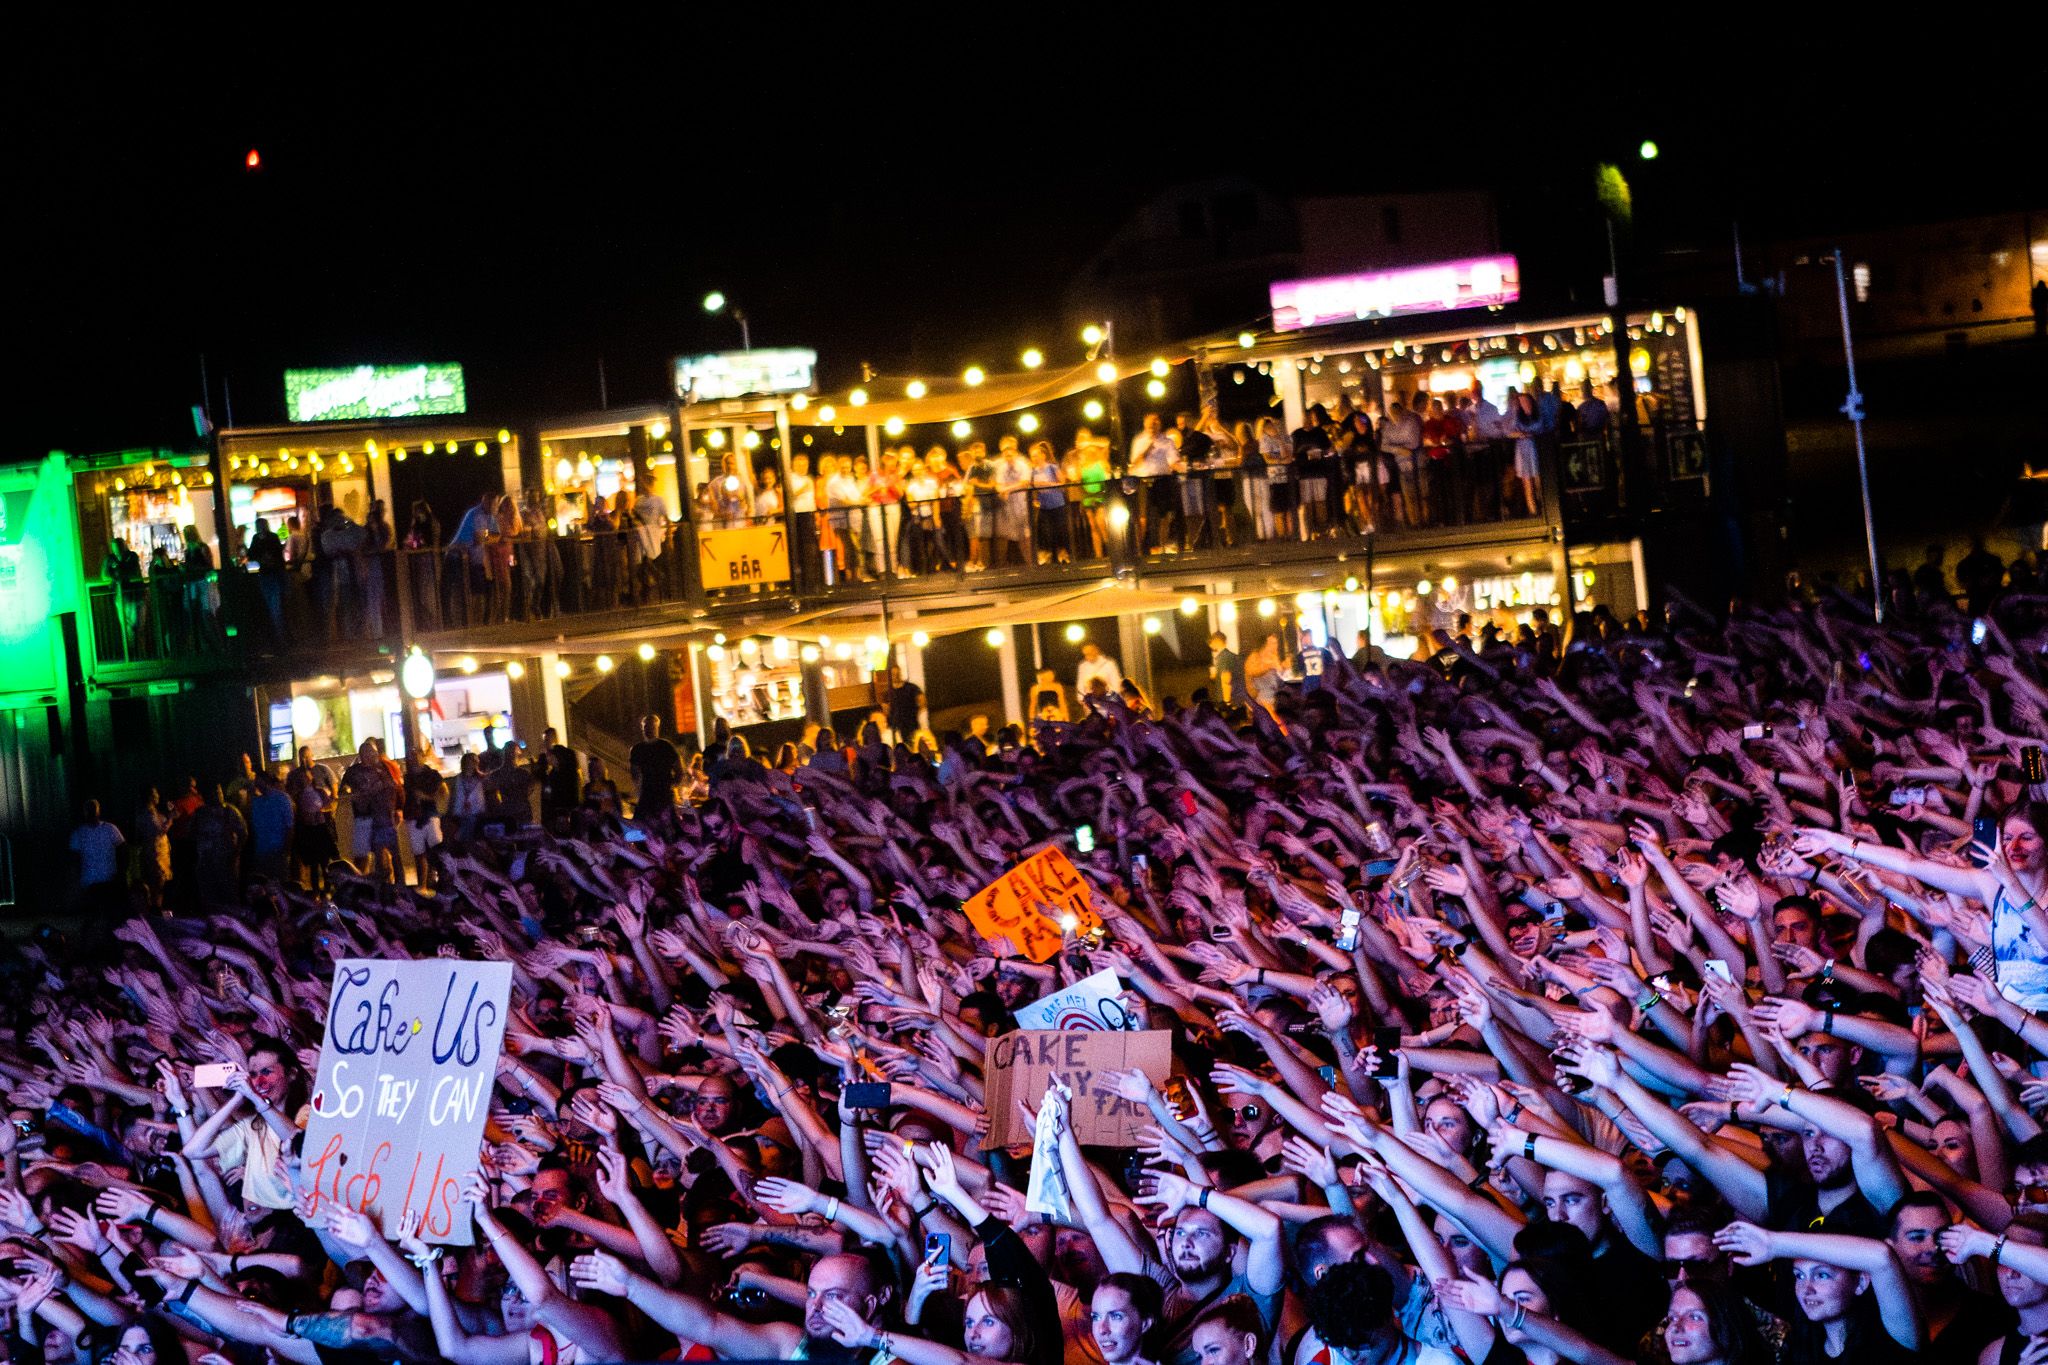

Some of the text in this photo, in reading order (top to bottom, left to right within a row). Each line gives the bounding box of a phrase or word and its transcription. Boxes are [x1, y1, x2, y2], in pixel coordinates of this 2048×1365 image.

[985, 849, 1079, 928] CAKE
[994, 1033, 1088, 1069] CAKE
[376, 1074, 419, 1125] THEY
[429, 1071, 485, 1127] CAN
[1047, 1070, 1093, 1097] MY
